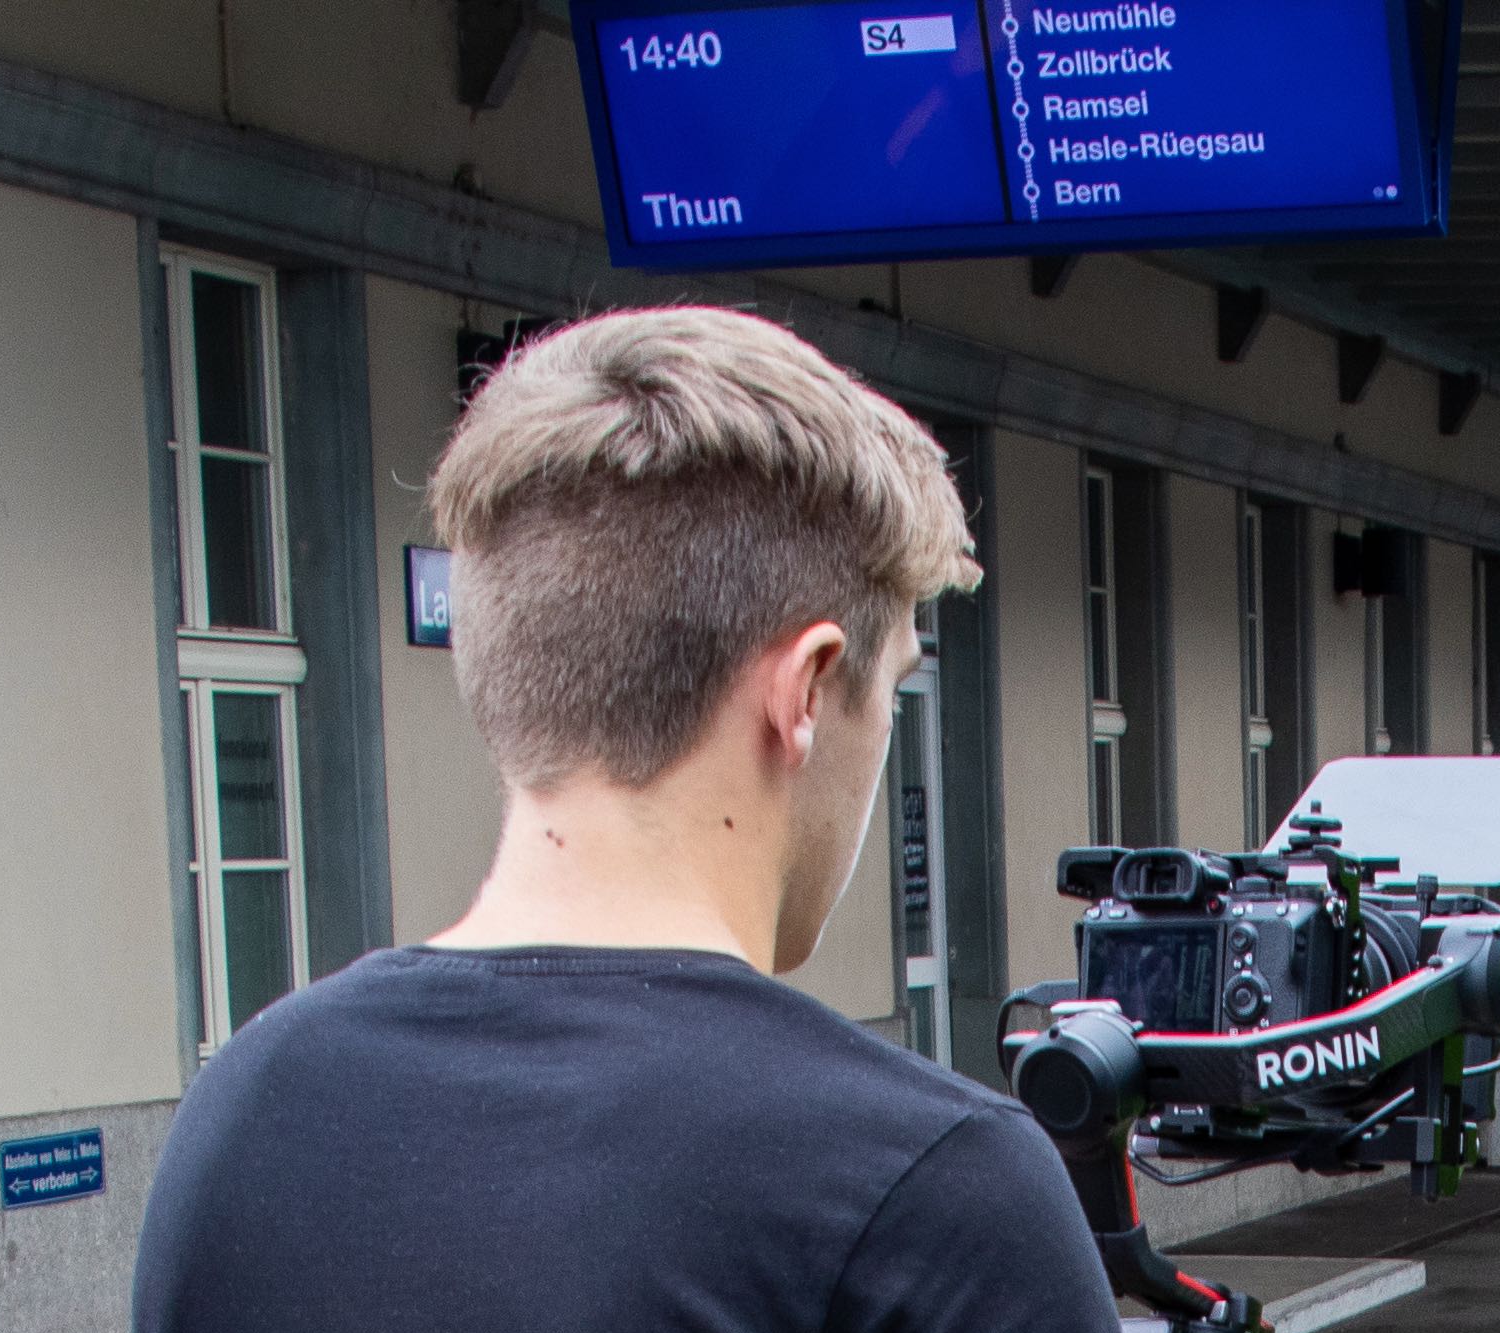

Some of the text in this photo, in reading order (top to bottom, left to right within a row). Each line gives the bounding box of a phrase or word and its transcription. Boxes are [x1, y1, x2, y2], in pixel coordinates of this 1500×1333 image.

[1033, 2, 1177, 35] Neumühle
[620, 31, 723, 71] 14:40
[866, 22, 906, 51] S4
[1037, 46, 1174, 78] Zollbrück
[1043, 90, 1149, 121] Ramsei
[1049, 130, 1265, 165] Hasle-Rüegsau
[1054, 179, 1122, 206] Bern
[642, 193, 743, 228] Thun
[419, 579, 452, 628] La
[1256, 1026, 1381, 1090] RONIN
